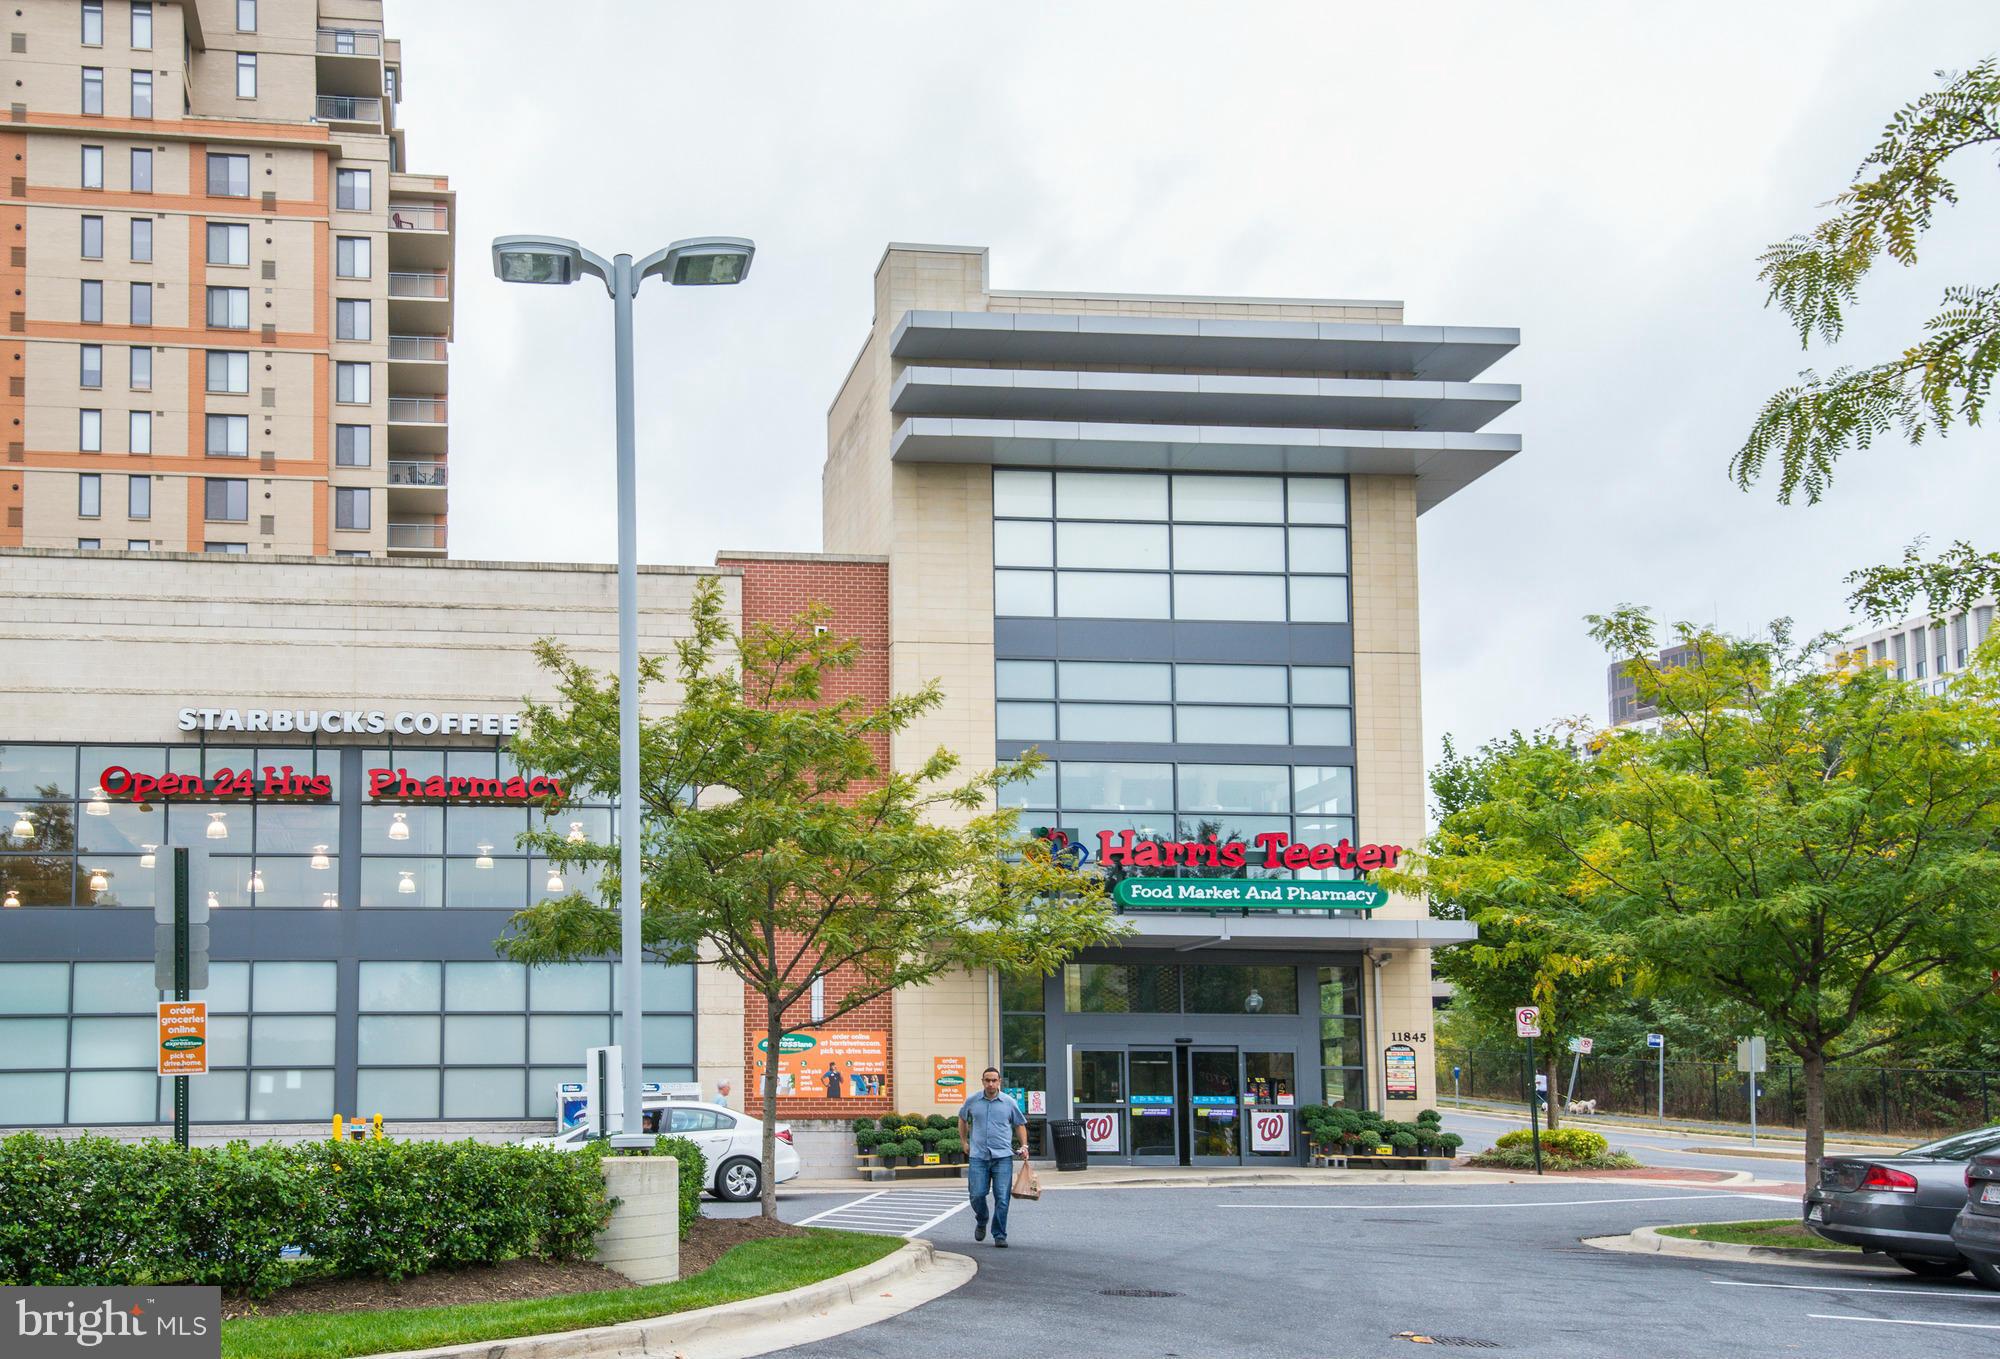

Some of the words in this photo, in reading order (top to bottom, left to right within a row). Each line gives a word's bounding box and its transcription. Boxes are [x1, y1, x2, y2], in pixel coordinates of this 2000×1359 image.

[177, 707, 387, 735] STARBUCKS
[394, 710, 519, 736] COFFEE
[100, 765, 204, 802] Open
[213, 767, 255, 796] 24
[263, 765, 332, 797] Hrs
[1096, 828, 1248, 869] Harris
[1254, 831, 1402, 871] Teeter
[1131, 884, 1173, 899] Food
[1178, 884, 1241, 901] Market
[1247, 886, 1282, 901] And
[1287, 887, 1377, 905] Pharmacy
[170, 1006, 196, 1015] order
[161, 1016, 205, 1026] groceries
[1391, 1031, 1427, 1043] 11845
[820, 1047, 834, 1055] pick
